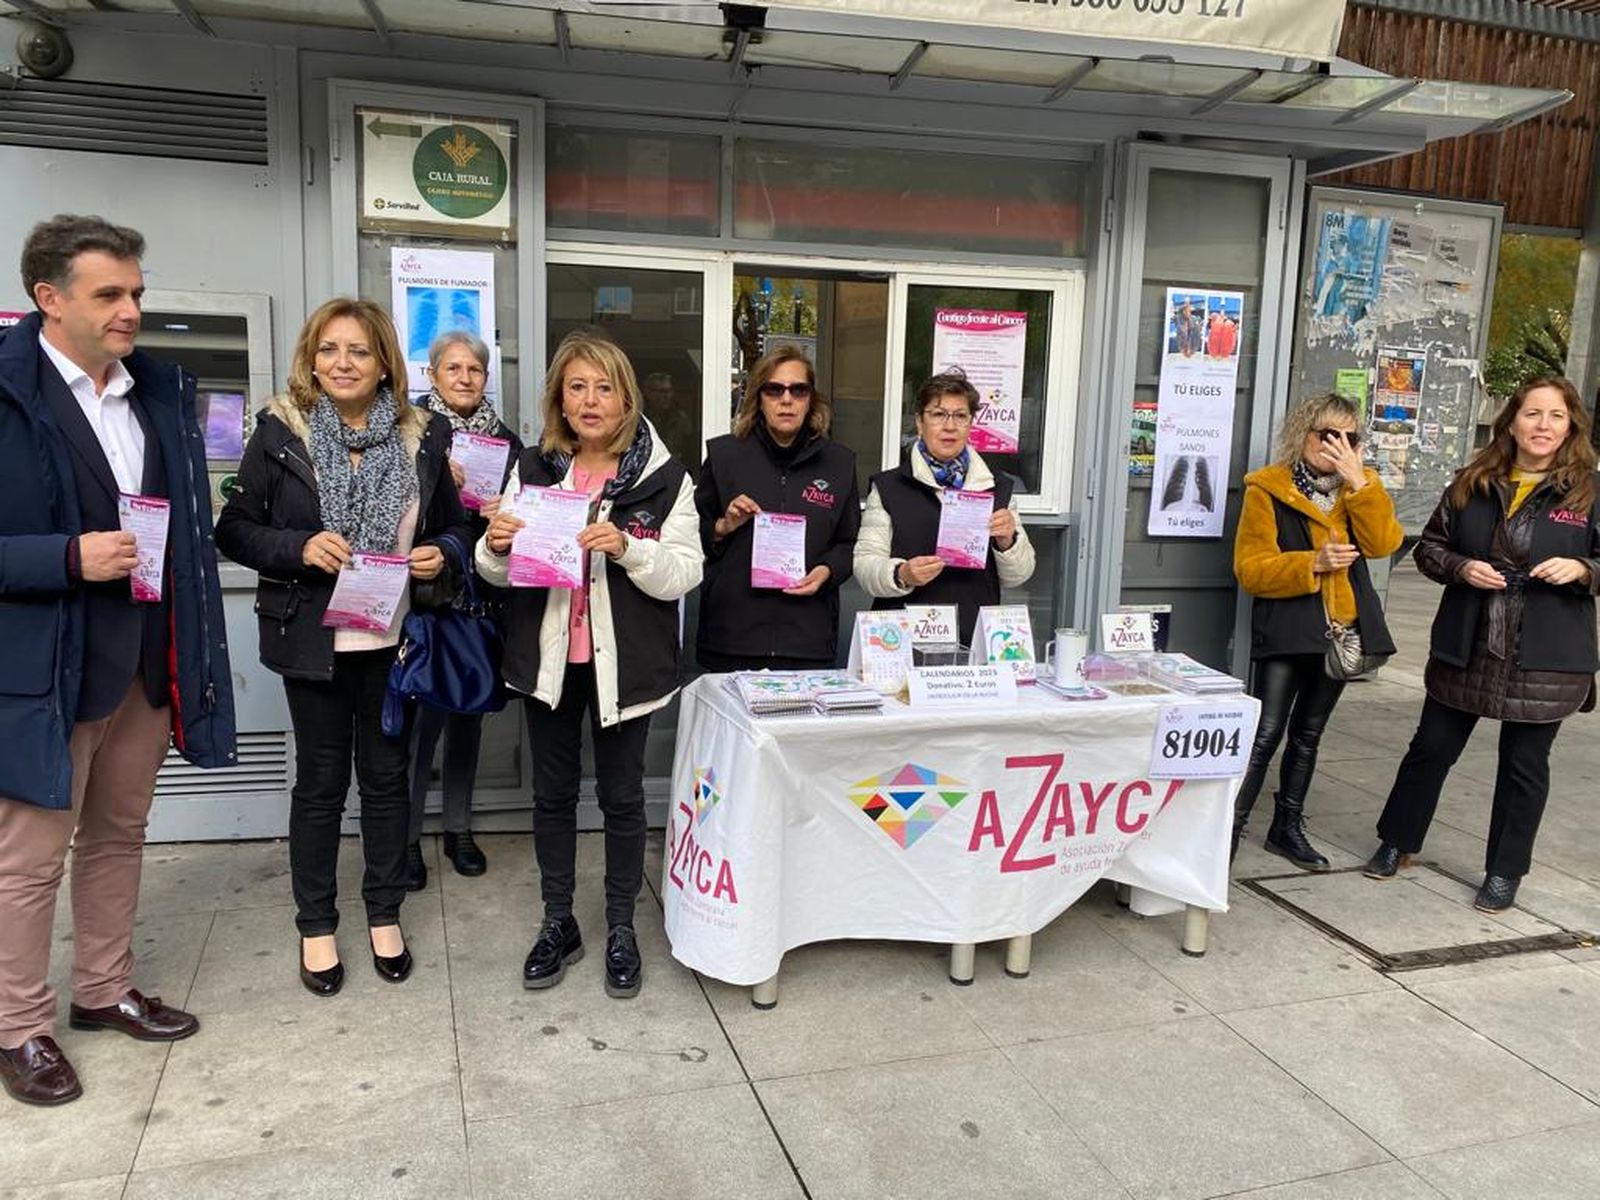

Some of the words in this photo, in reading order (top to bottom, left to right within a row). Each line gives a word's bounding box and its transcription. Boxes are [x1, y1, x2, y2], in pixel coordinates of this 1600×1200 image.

[428, 171, 454, 182] CAJA
[456, 174, 493, 186] RURAL
[386, 201, 420, 211] ServiRed
[1326, 213, 1345, 229] 8M
[397, 277, 438, 286] PULMONES
[450, 280, 488, 288] FUMADOR
[1174, 382, 1187, 395] TÚ
[1189, 384, 1222, 397] ELIGES
[1175, 427, 1220, 439] PULMONES
[1179, 442, 1206, 453] SANOS
[801, 486, 834, 503] AZAYCA
[1167, 516, 1178, 527] Tú
[1180, 517, 1205, 530] eliges
[914, 620, 950, 639] AZAYCA
[1110, 627, 1146, 648] AZAYCA
[920, 669, 975, 678] CALENDARIOS
[966, 679, 973, 688] 2
[1162, 727, 1241, 759] 81904
